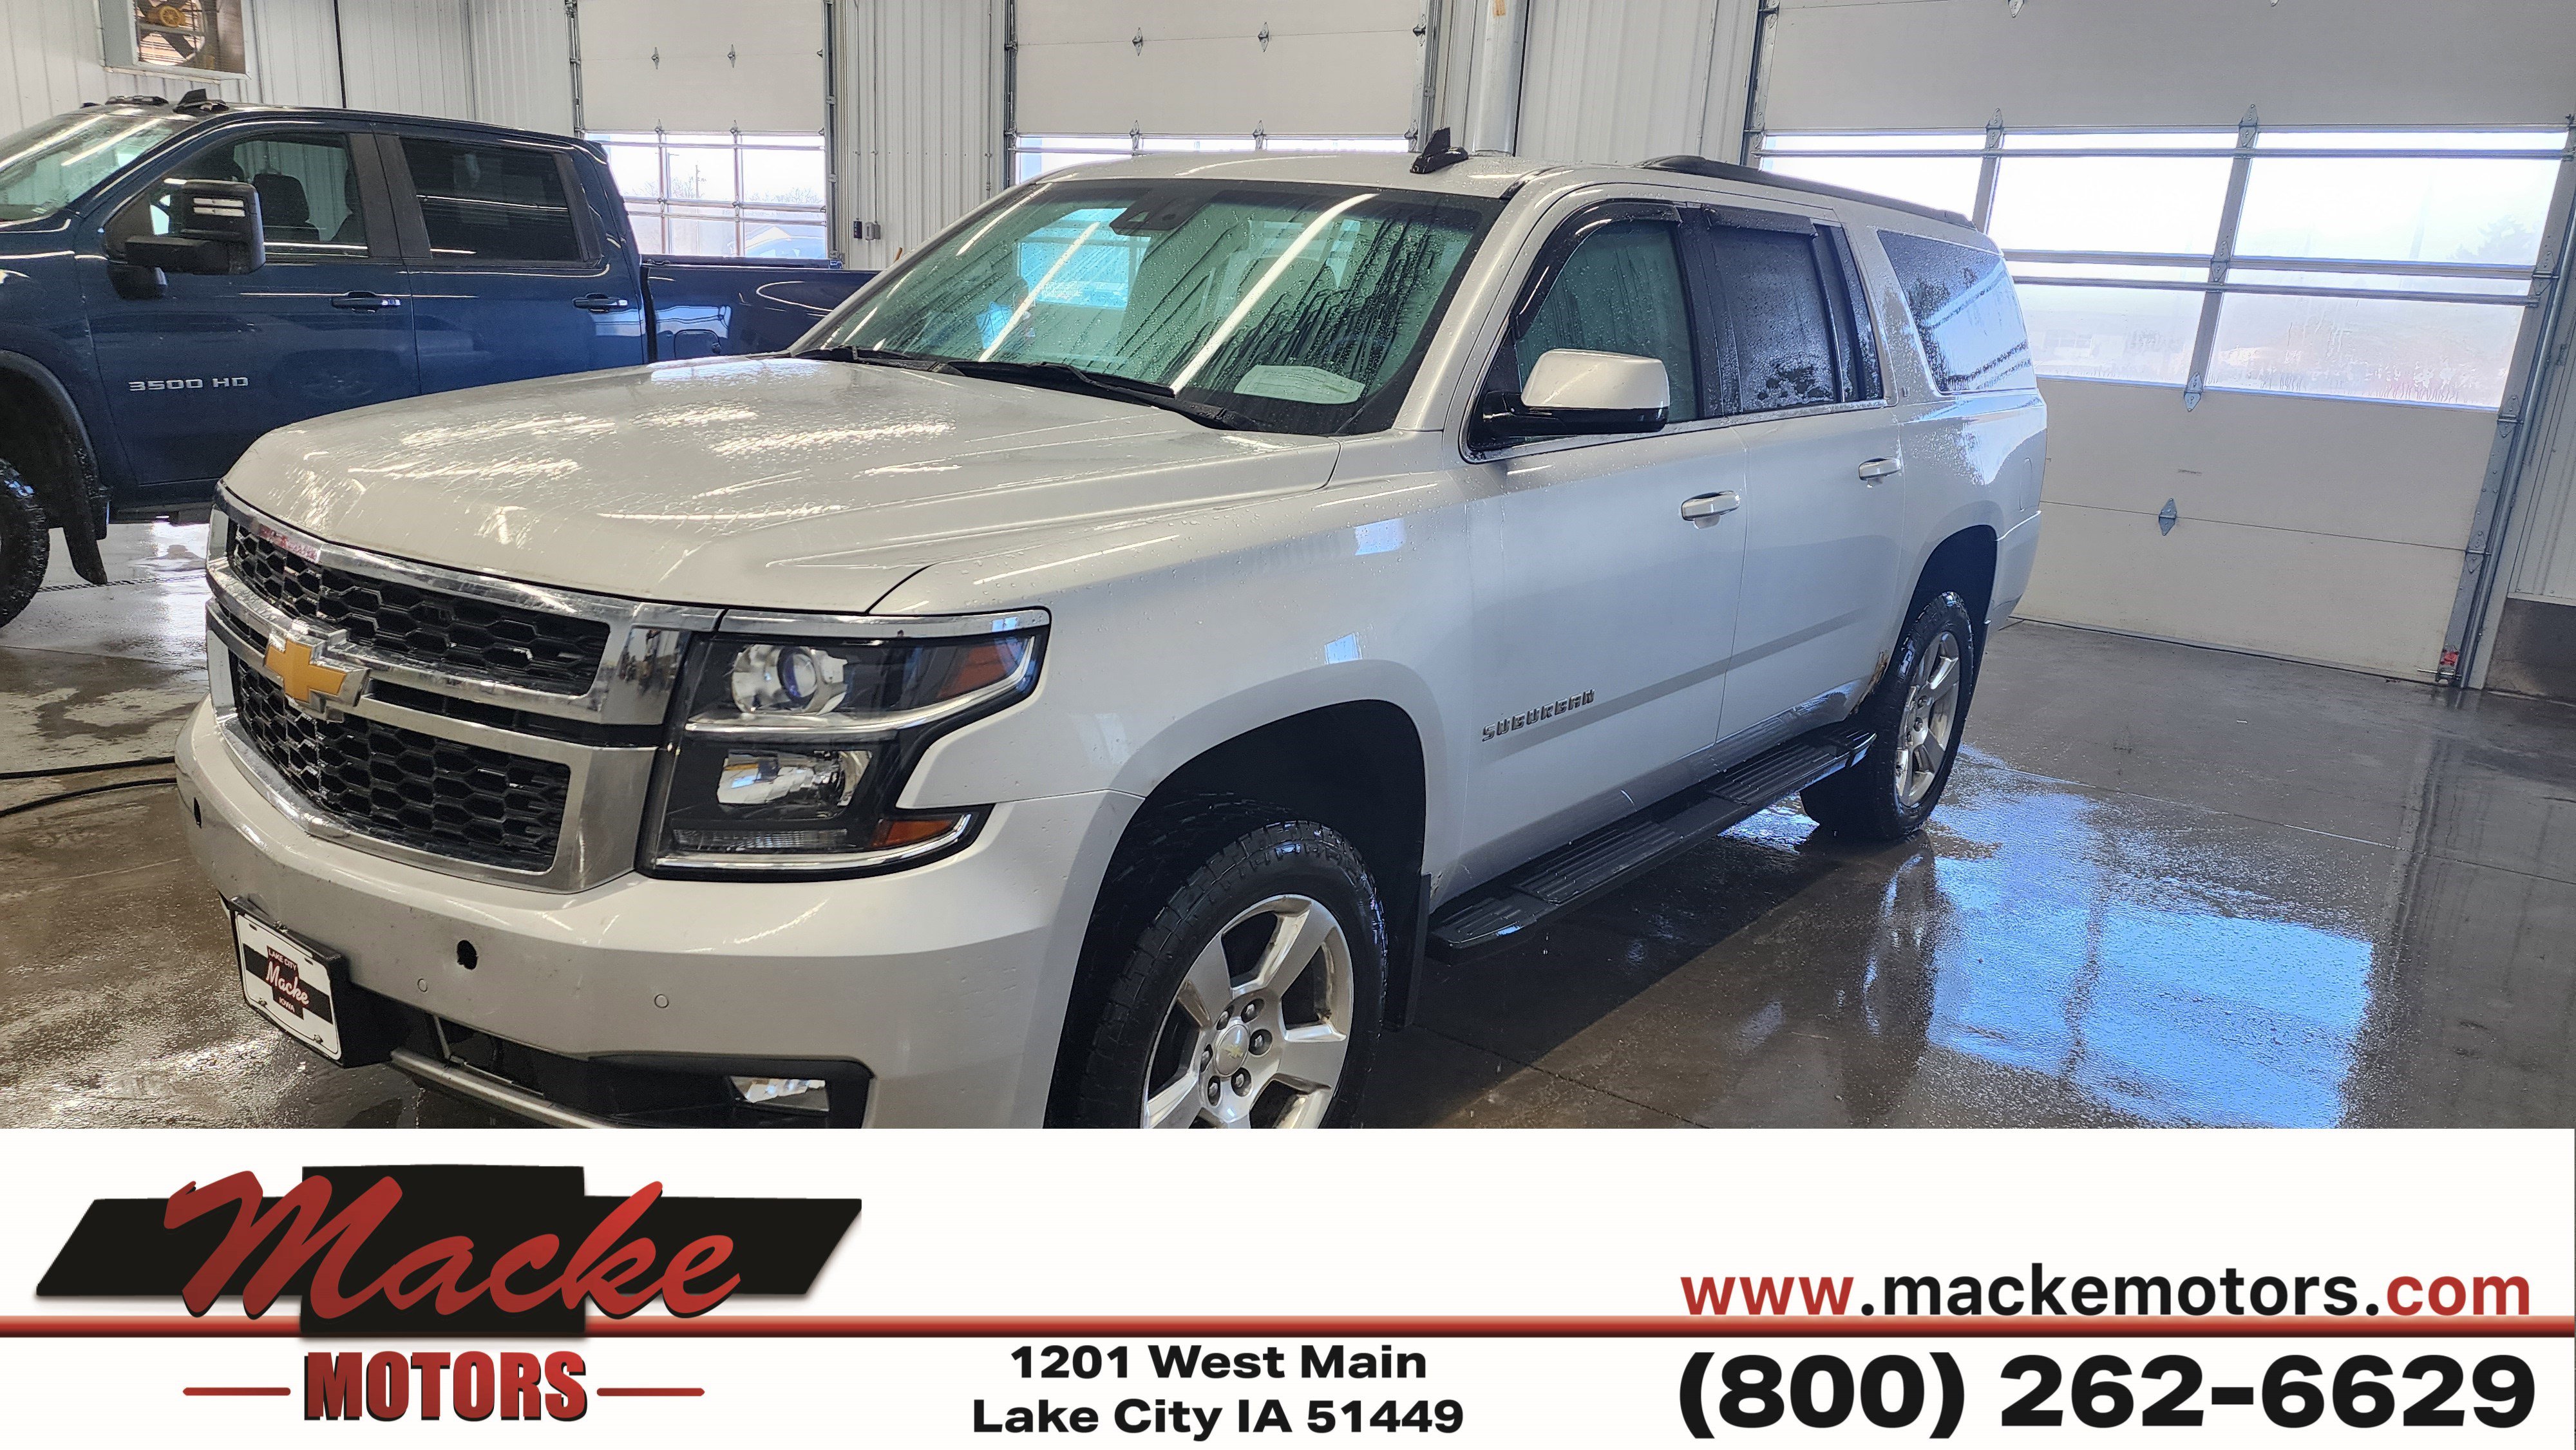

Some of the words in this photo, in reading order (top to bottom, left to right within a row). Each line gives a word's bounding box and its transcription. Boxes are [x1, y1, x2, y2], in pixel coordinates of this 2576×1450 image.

[129, 379, 203, 391] 3500
[212, 377, 249, 388] HD
[1482, 688, 1595, 742] SUBURBAN
[269, 948, 284, 963] LAKE
[284, 958, 297, 971] CITY
[265, 961, 310, 1005] Macke
[279, 996, 296, 1013] IOWA
